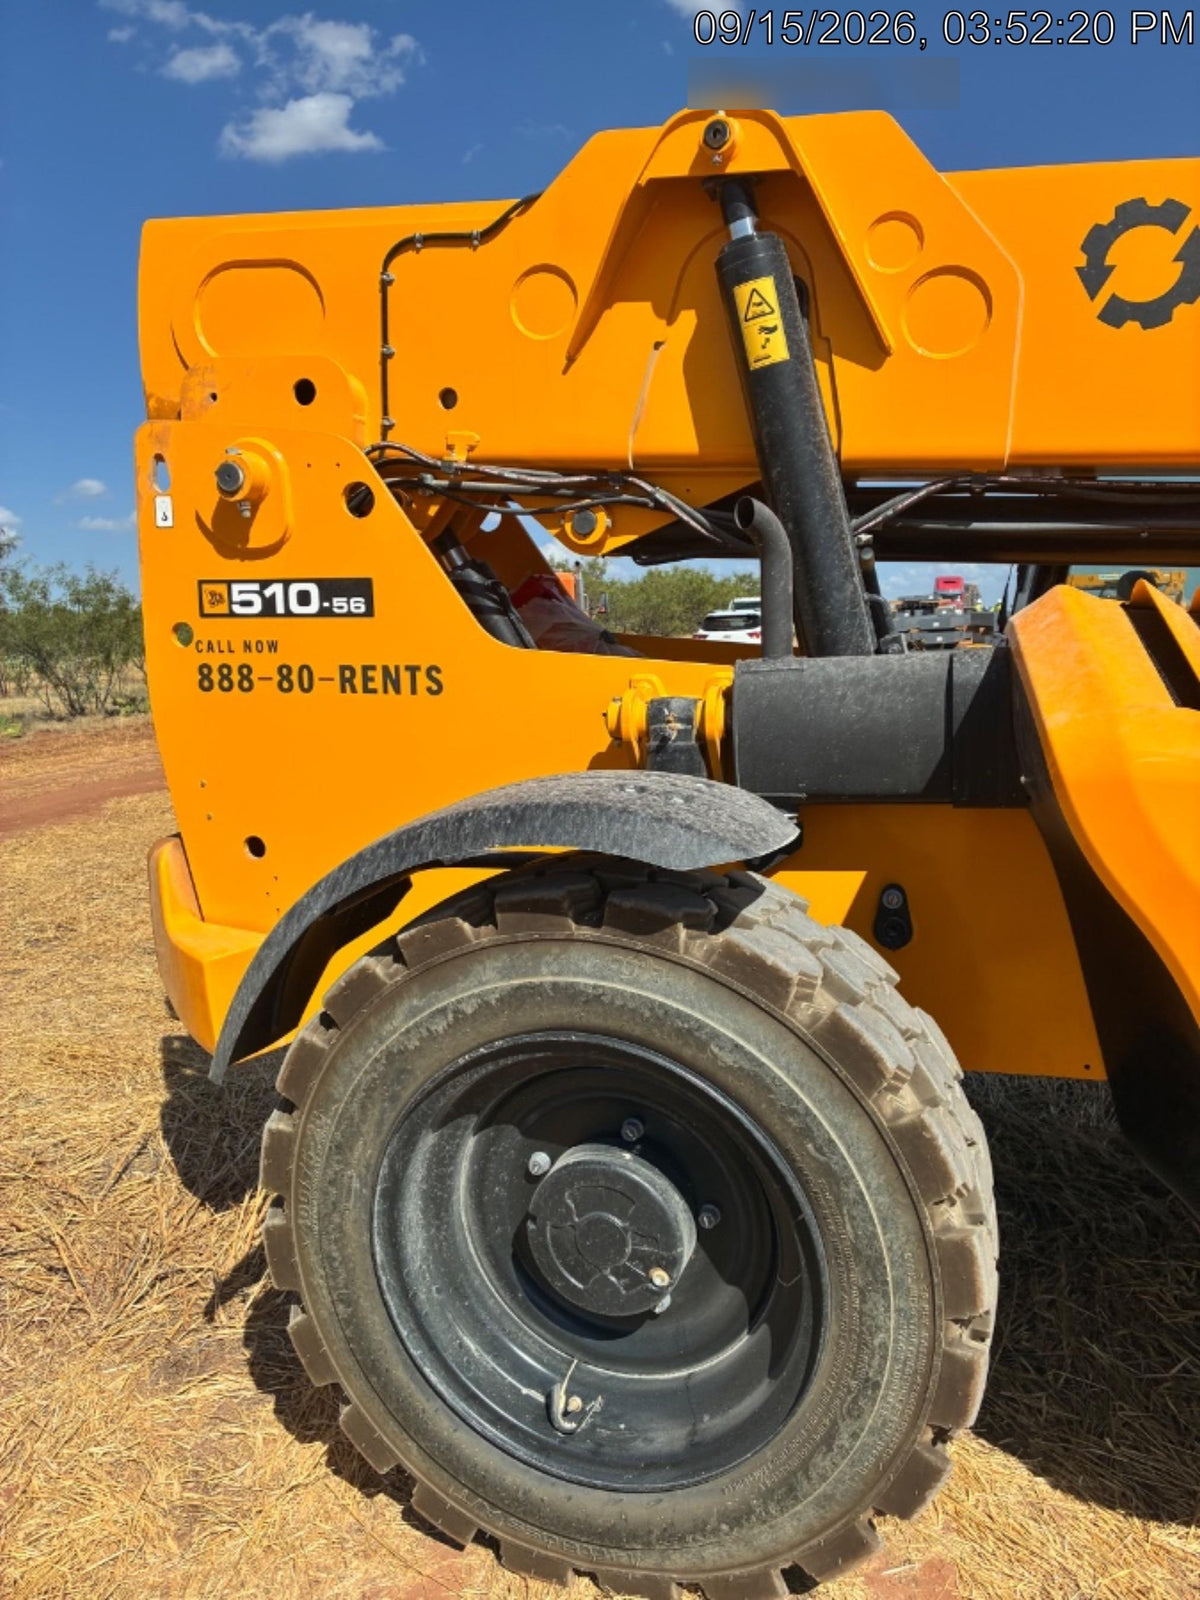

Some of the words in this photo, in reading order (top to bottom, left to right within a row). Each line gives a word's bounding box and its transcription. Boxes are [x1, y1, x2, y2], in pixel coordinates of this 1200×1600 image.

[230, 582, 366, 615] 510-56
[195, 639, 235, 653] CALL
[243, 639, 278, 653] NOW
[198, 662, 444, 696] 888-80-RENTS
